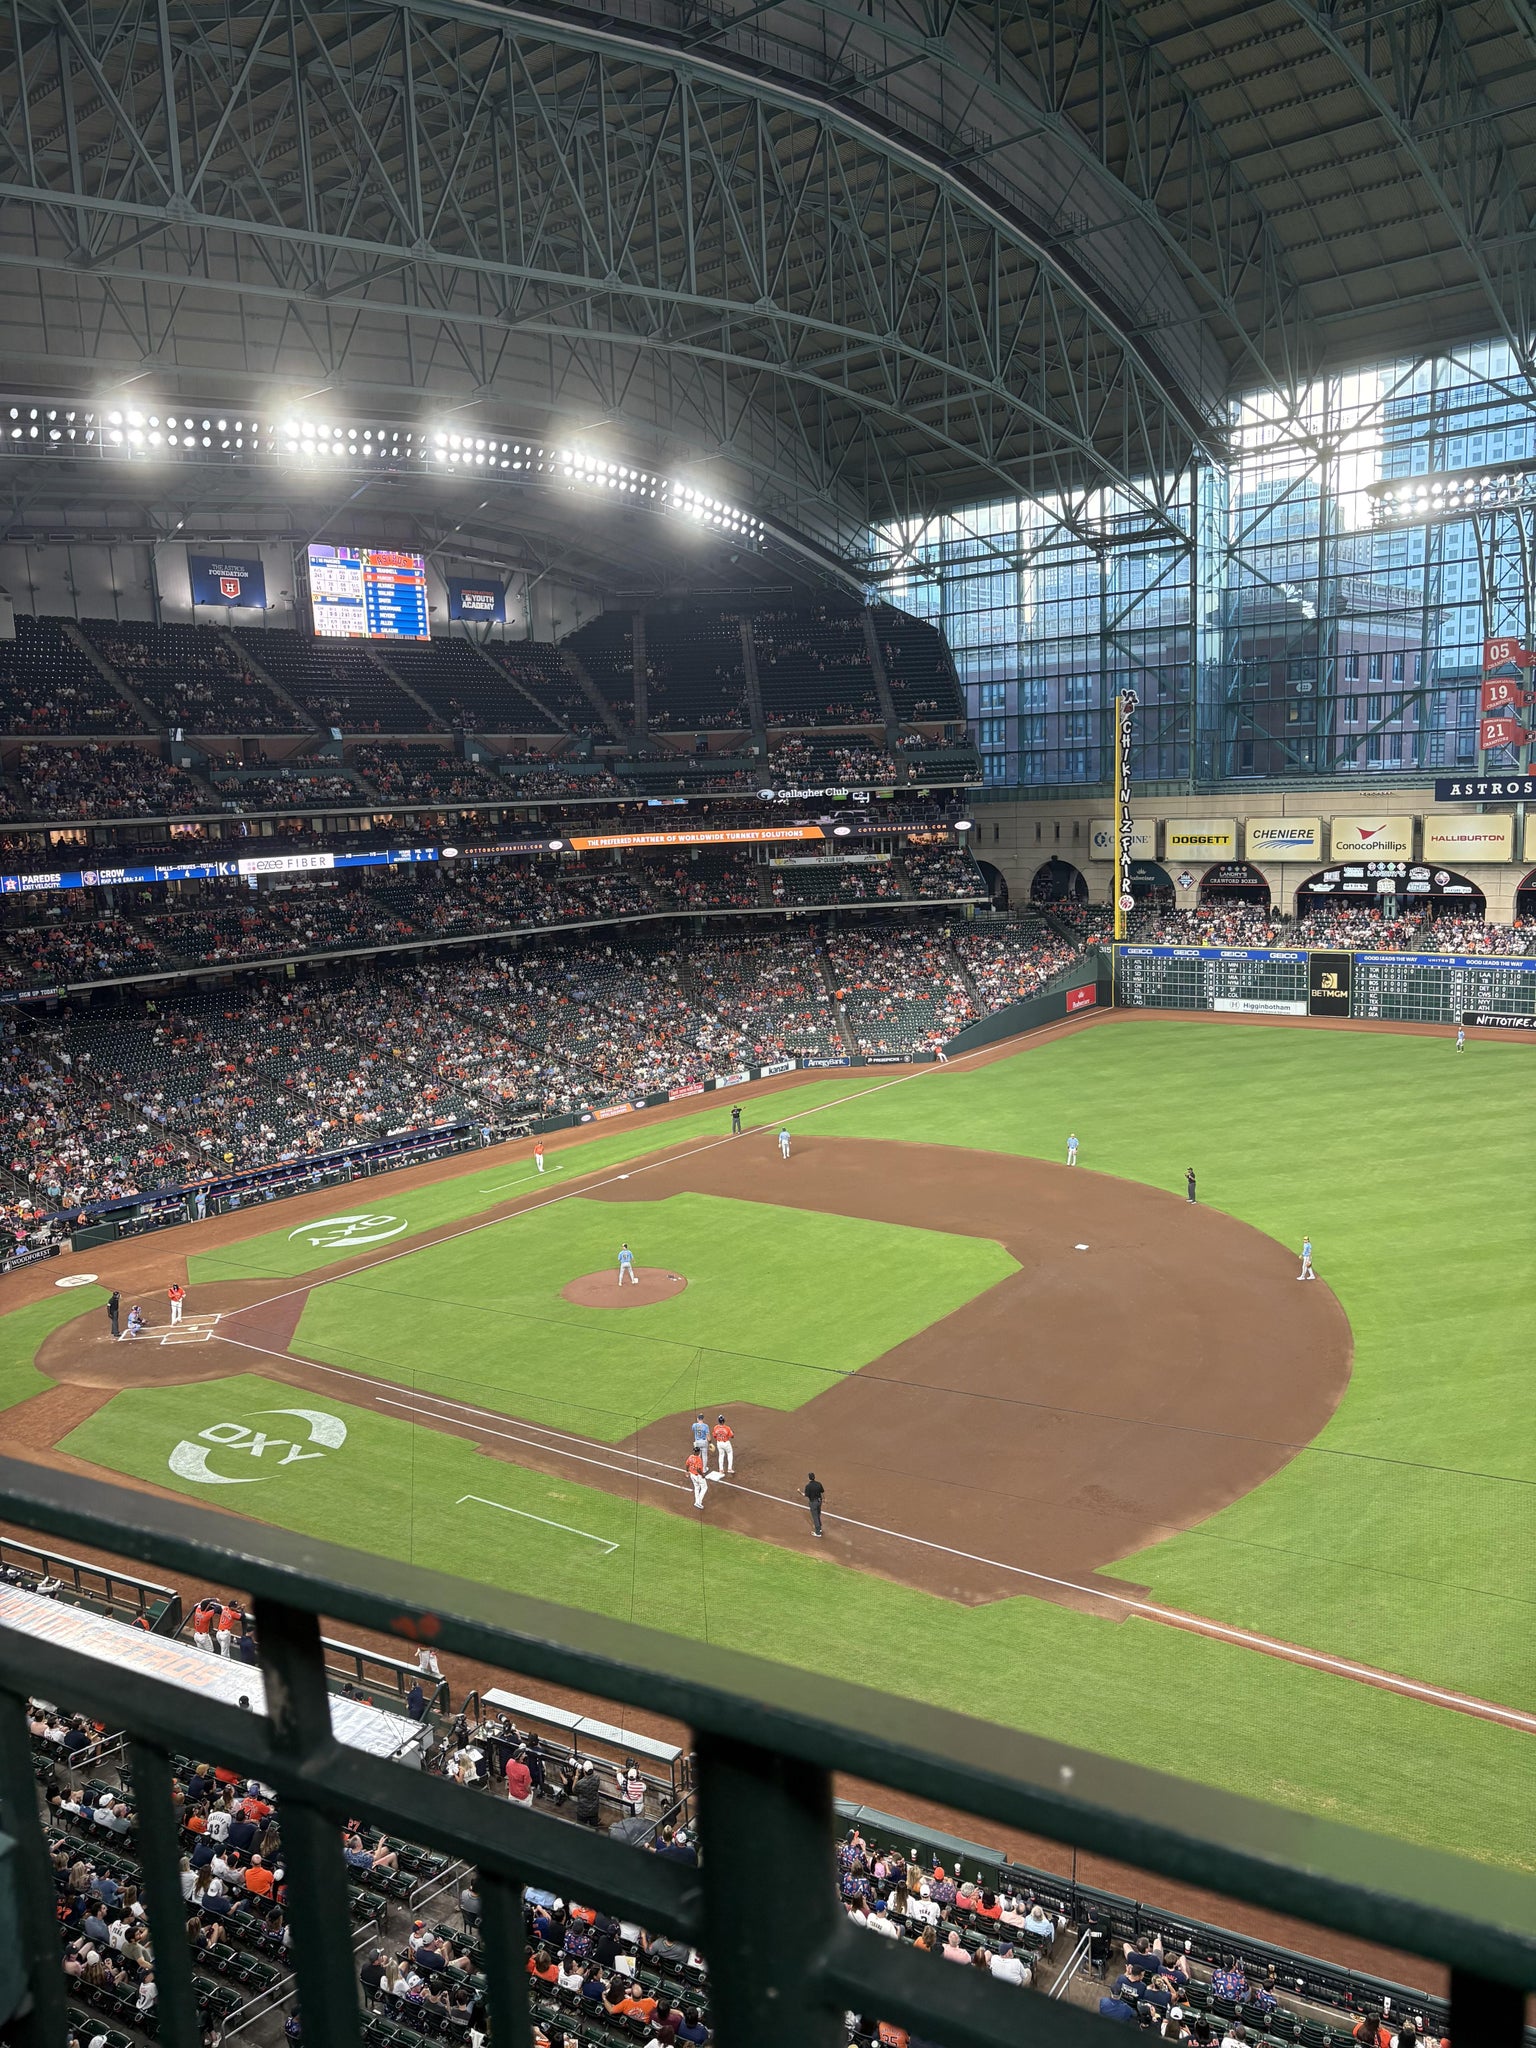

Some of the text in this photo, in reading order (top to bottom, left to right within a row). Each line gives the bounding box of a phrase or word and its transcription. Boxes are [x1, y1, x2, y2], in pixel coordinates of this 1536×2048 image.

[377, 554, 407, 568] ASTROS
[209, 570, 249, 578] FOUNDATION
[226, 584, 234, 592] H
[462, 601, 494, 610] ACADEMY
[1490, 644, 1510, 660] 05
[1487, 656, 1516, 670] CHAMPIONS
[1490, 686, 1508, 700] 19
[1486, 697, 1514, 709] CHAMPIONS
[1487, 724, 1504, 739] 21
[1483, 737, 1509, 748] CHAMPIONS
[1121, 720, 1132, 804] CHIKIN
[778, 787, 849, 799] Gallagher Club
[1450, 782, 1533, 795] ASTROS
[858, 824, 947, 833] COTTONCOMPANIES.COM
[1253, 829, 1315, 839] CHENIERE
[633, 836, 664, 844] PARTNER
[678, 833, 724, 841] WORLDWIDE
[1172, 836, 1230, 844] DOGGETT
[464, 844, 543, 854] COTTONCOMPANIES.COM
[1336, 841, 1407, 852] ConocoPhillips
[219, 862, 229, 875] K
[257, 857, 326, 870] ezee FIBER
[1120, 837, 1132, 895] FAIR
[22, 874, 61, 884] PAREDES
[100, 869, 125, 878] CROW
[1312, 990, 1348, 998] BETMGM
[1244, 1002, 1290, 1011] Higginbotham
[307, 1215, 397, 1246] OXY
[11, 1248, 51, 1266] WOODFOREST
[198, 1422, 327, 1465] OXY
